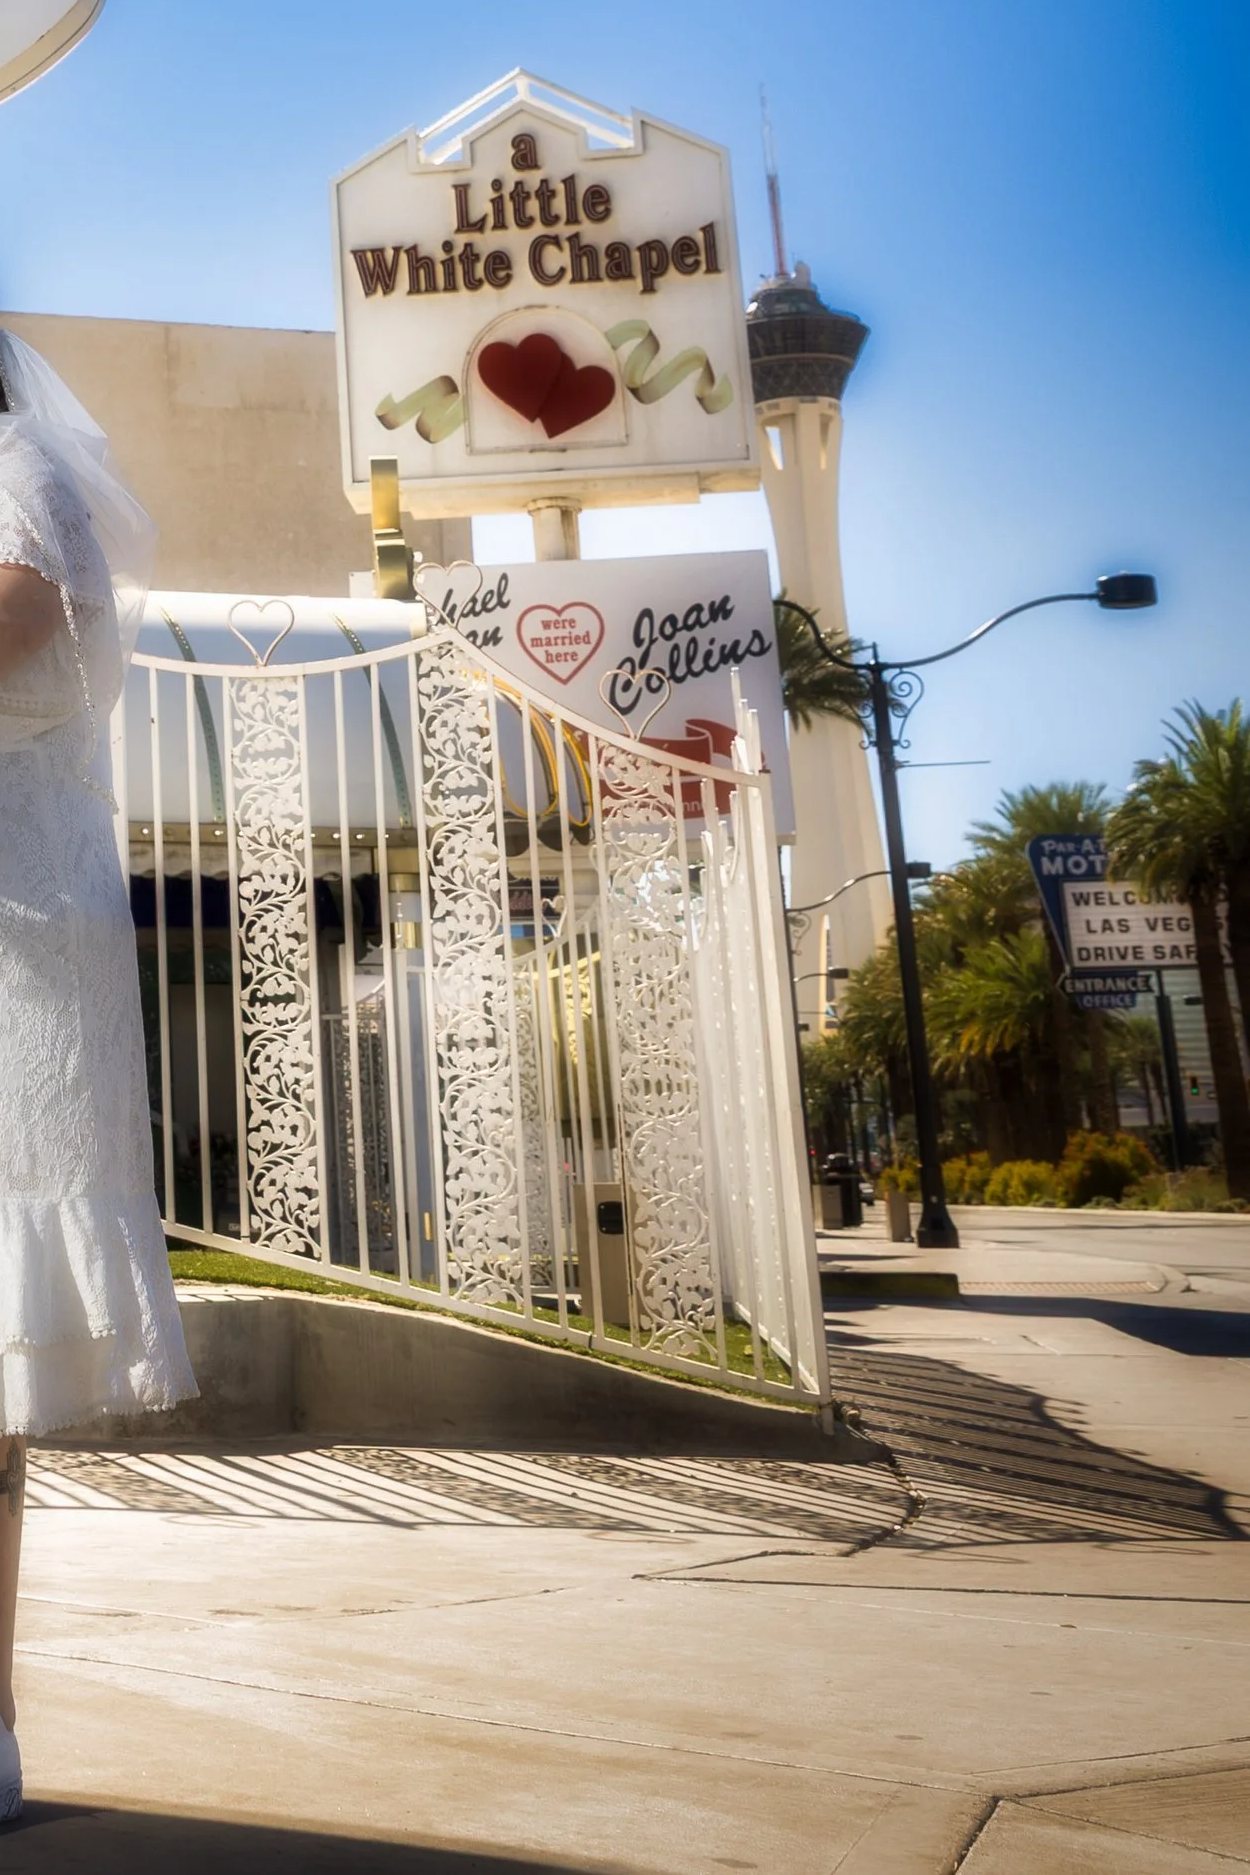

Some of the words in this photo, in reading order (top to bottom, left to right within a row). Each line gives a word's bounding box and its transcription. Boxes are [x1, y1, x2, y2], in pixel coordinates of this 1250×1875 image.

[510, 132, 540, 171] a
[451, 174, 613, 235] Little
[350, 239, 514, 300] White
[527, 221, 723, 294] Chapel
[541, 617, 577, 630] were
[633, 595, 735, 670] Joan
[530, 631, 591, 648] married
[545, 650, 579, 664] here
[609, 629, 772, 716] Collins
[1041, 855, 1106, 876] MOT
[1085, 918, 1130, 934] LAS
[1145, 917, 1191, 932] VEG
[1077, 945, 1145, 962] DRIVE
[1153, 944, 1198, 960] SAF
[1064, 976, 1148, 994] ENTRANCE
[1082, 994, 1134, 1008] OFFICE
